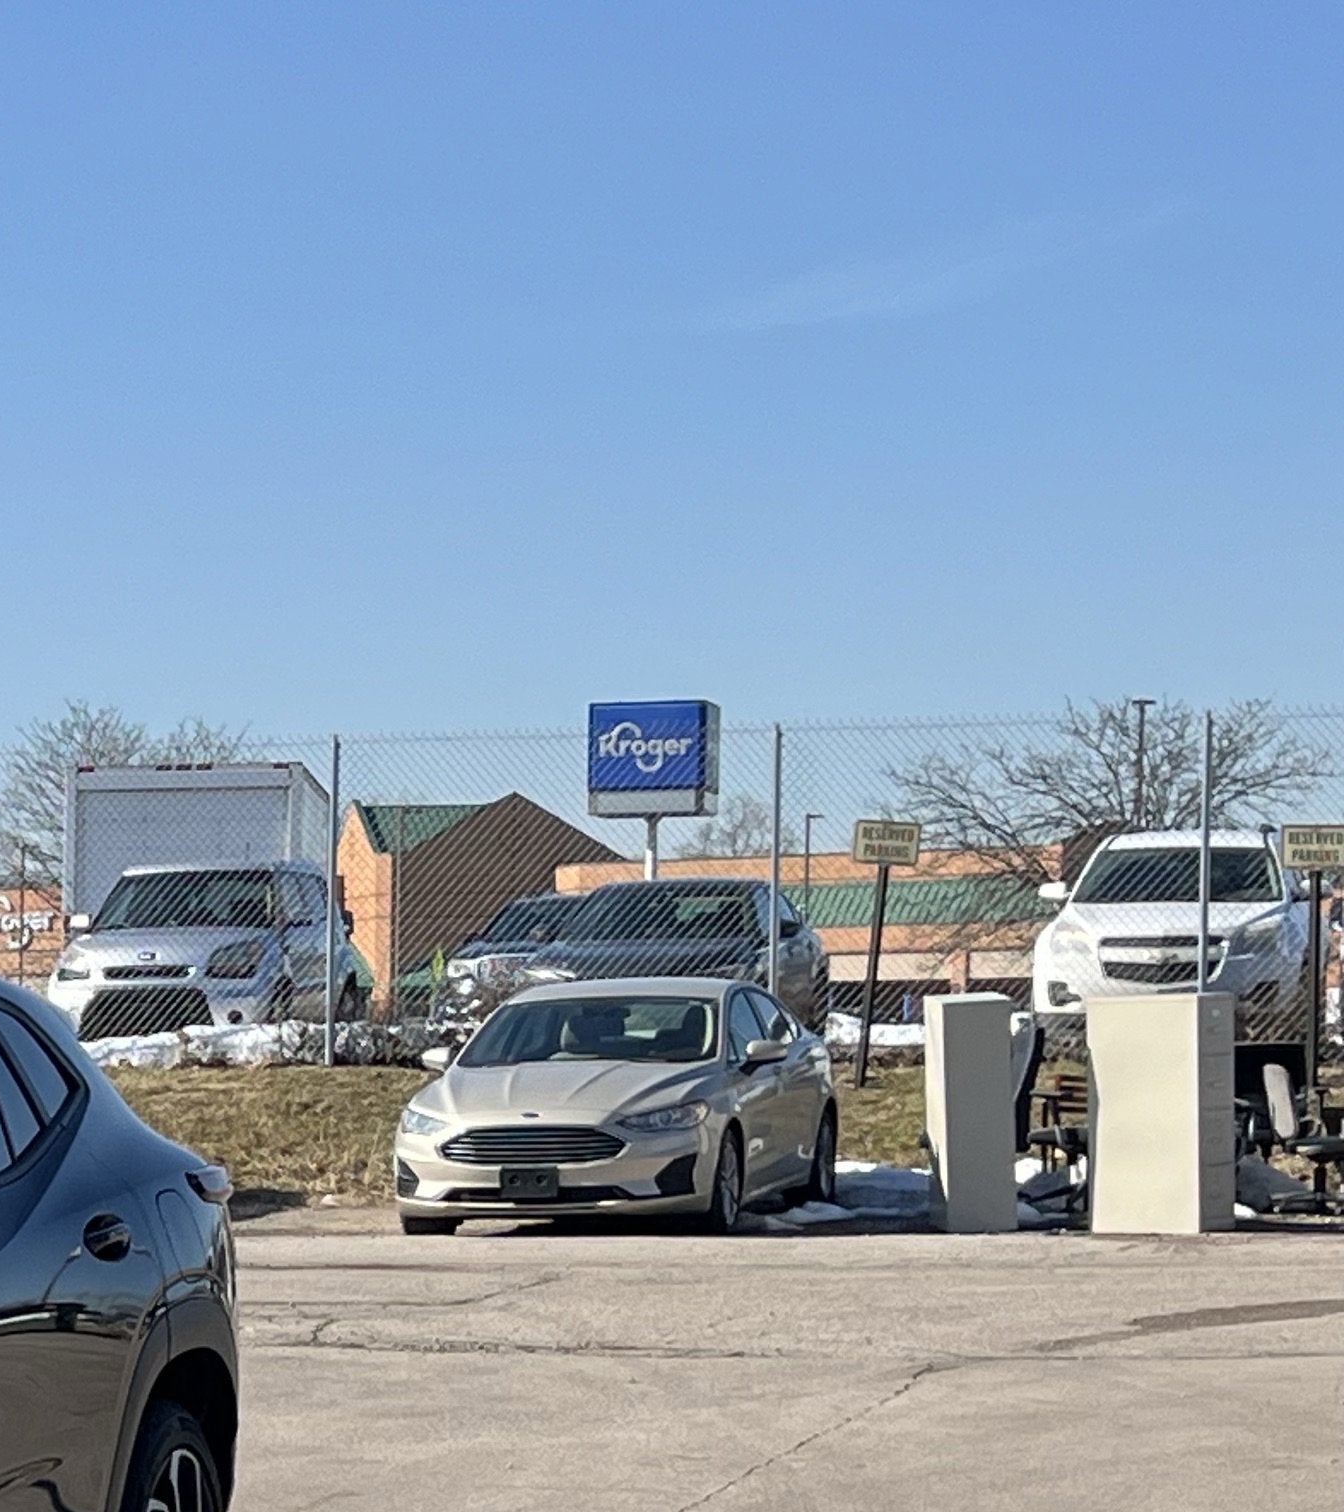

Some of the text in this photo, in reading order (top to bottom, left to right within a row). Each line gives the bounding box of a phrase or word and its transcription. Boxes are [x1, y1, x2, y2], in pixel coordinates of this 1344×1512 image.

[598, 721, 693, 773] Kroger
[862, 826, 915, 843] RESERVED
[1288, 831, 1344, 845] RESERVED
[863, 843, 910, 858] PARKING
[1292, 848, 1340, 863] PARKING
